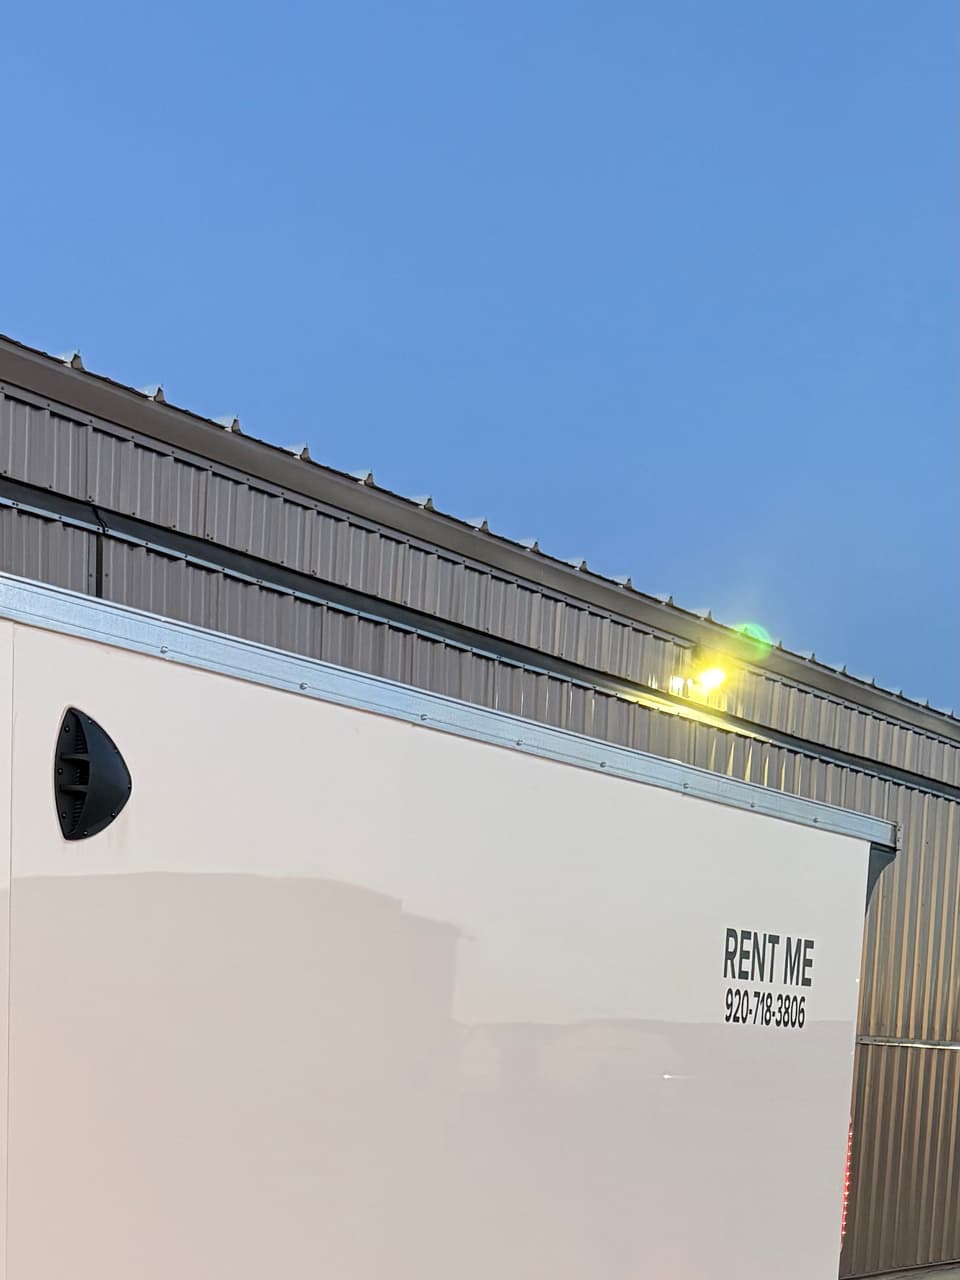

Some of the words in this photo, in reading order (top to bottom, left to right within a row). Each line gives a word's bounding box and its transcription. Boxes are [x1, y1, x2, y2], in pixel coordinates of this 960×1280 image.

[723, 927, 780, 983] RENT
[783, 936, 814, 987] ME
[725, 987, 806, 1028] 920-718-3806
